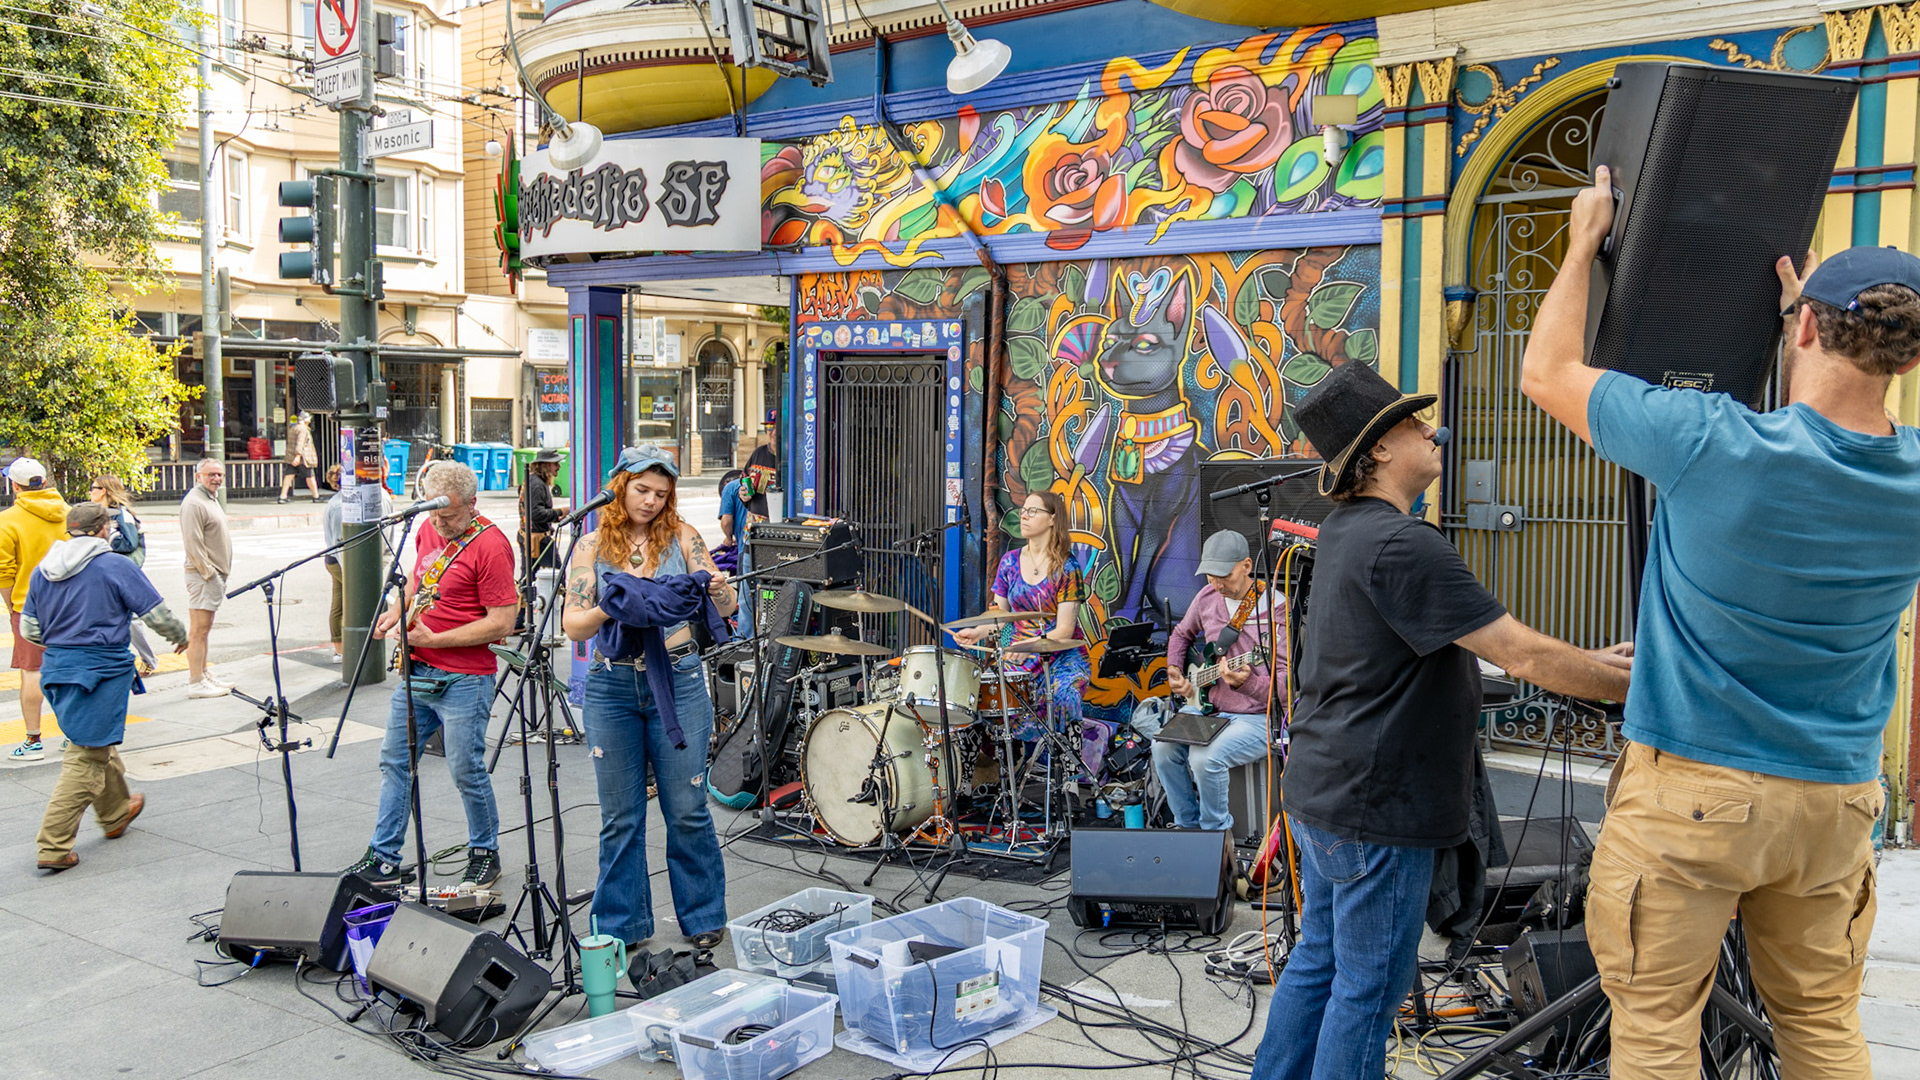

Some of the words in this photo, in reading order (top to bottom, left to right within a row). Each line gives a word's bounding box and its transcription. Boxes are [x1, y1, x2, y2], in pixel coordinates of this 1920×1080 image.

[317, 73, 340, 97] EXCEPT
[342, 67, 360, 91] MUNI
[375, 129, 420, 151] Masonic
[656, 160, 730, 227] SF
[543, 374, 568, 384] COPY
[1673, 379, 1703, 389] QSC
[544, 384, 568, 393] FAX
[541, 393, 569, 404] NOTARY
[541, 403, 569, 413] PASSPOR
[653, 403, 674, 413] FedEx
